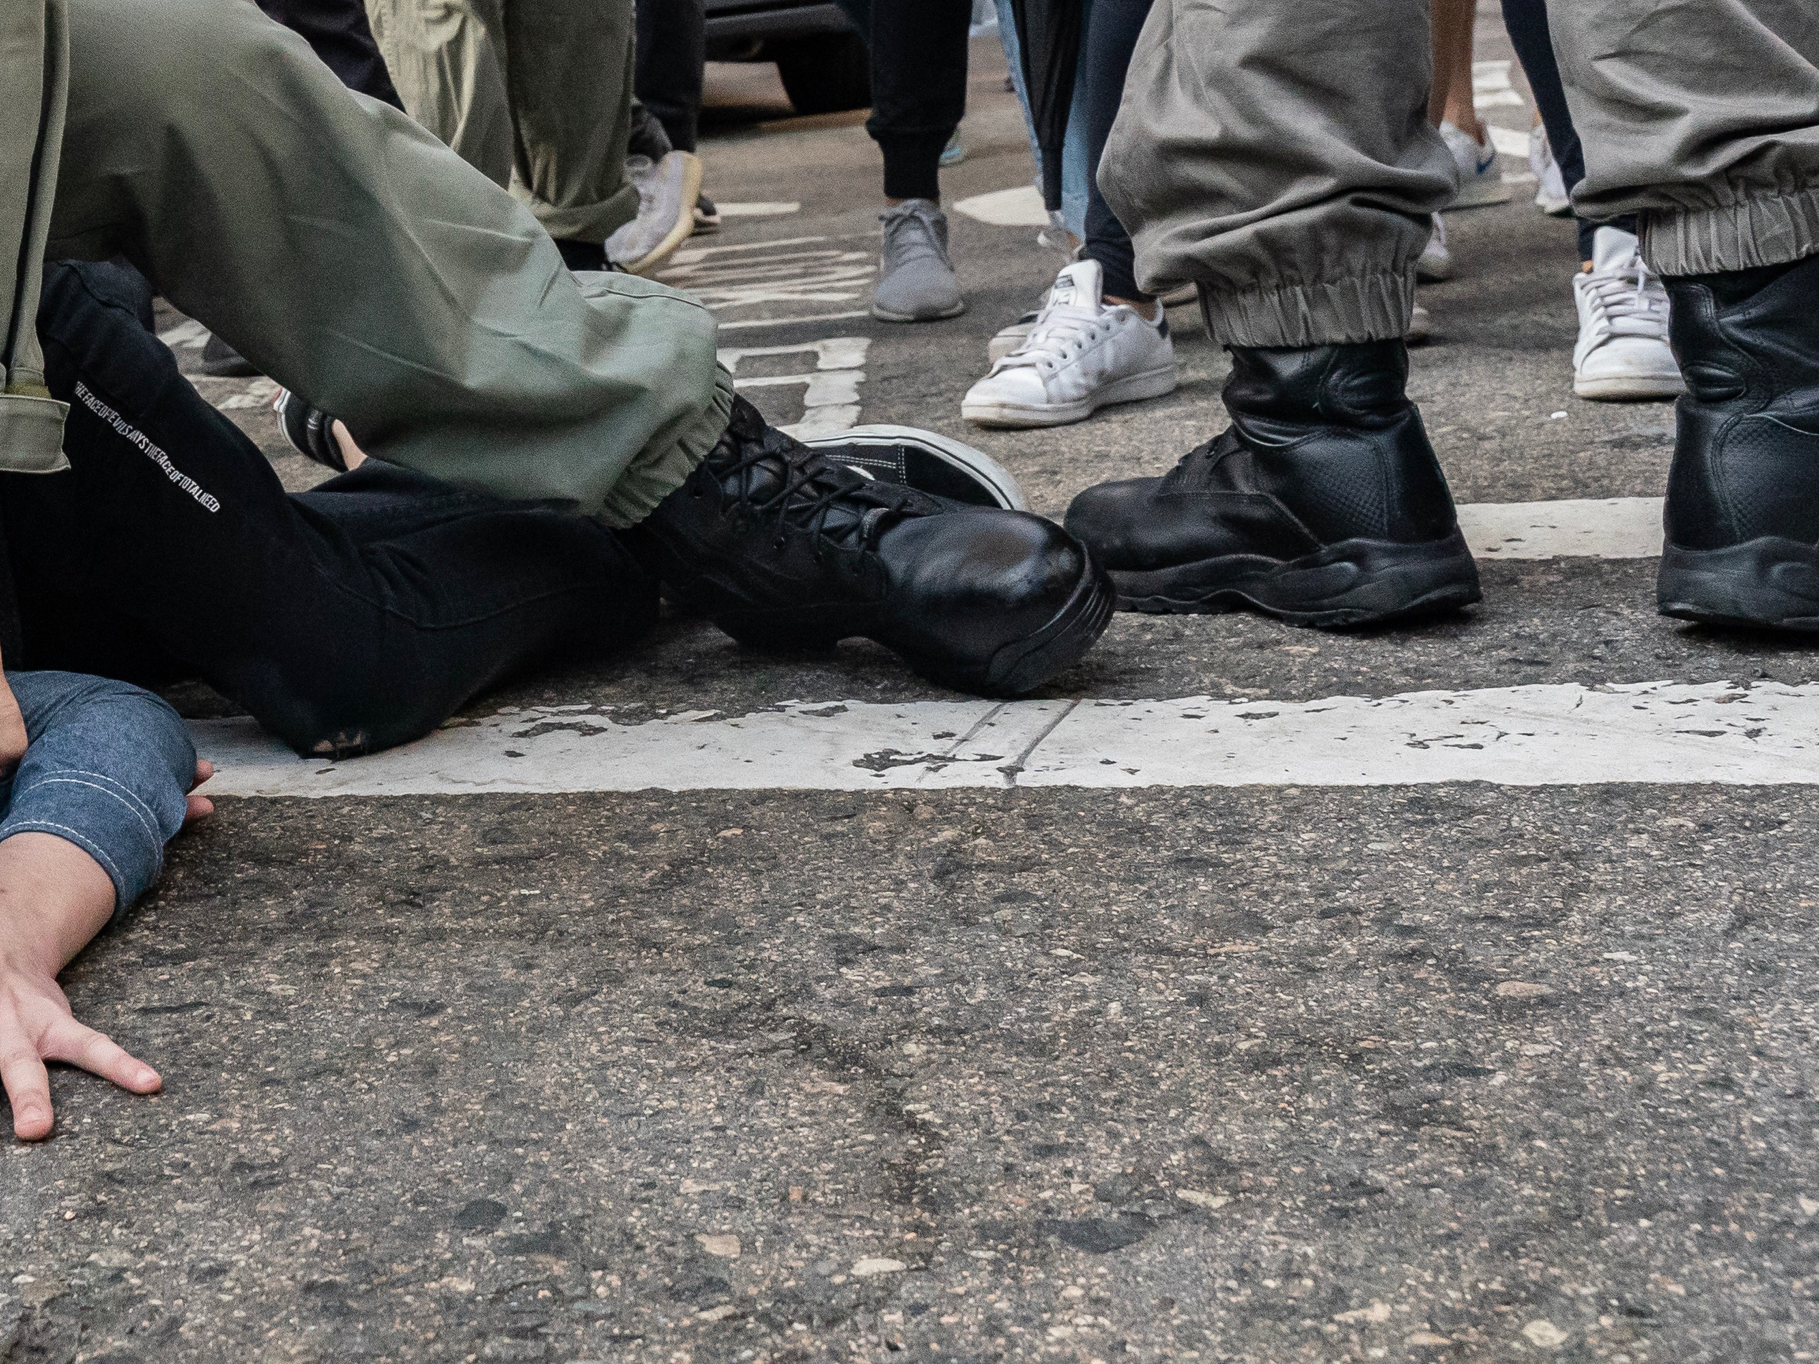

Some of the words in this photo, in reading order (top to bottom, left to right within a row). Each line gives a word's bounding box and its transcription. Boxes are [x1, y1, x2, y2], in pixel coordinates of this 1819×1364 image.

[155, 451, 176, 477] FACE
[178, 476, 204, 501] TOTAL
[199, 493, 221, 513] NEED
